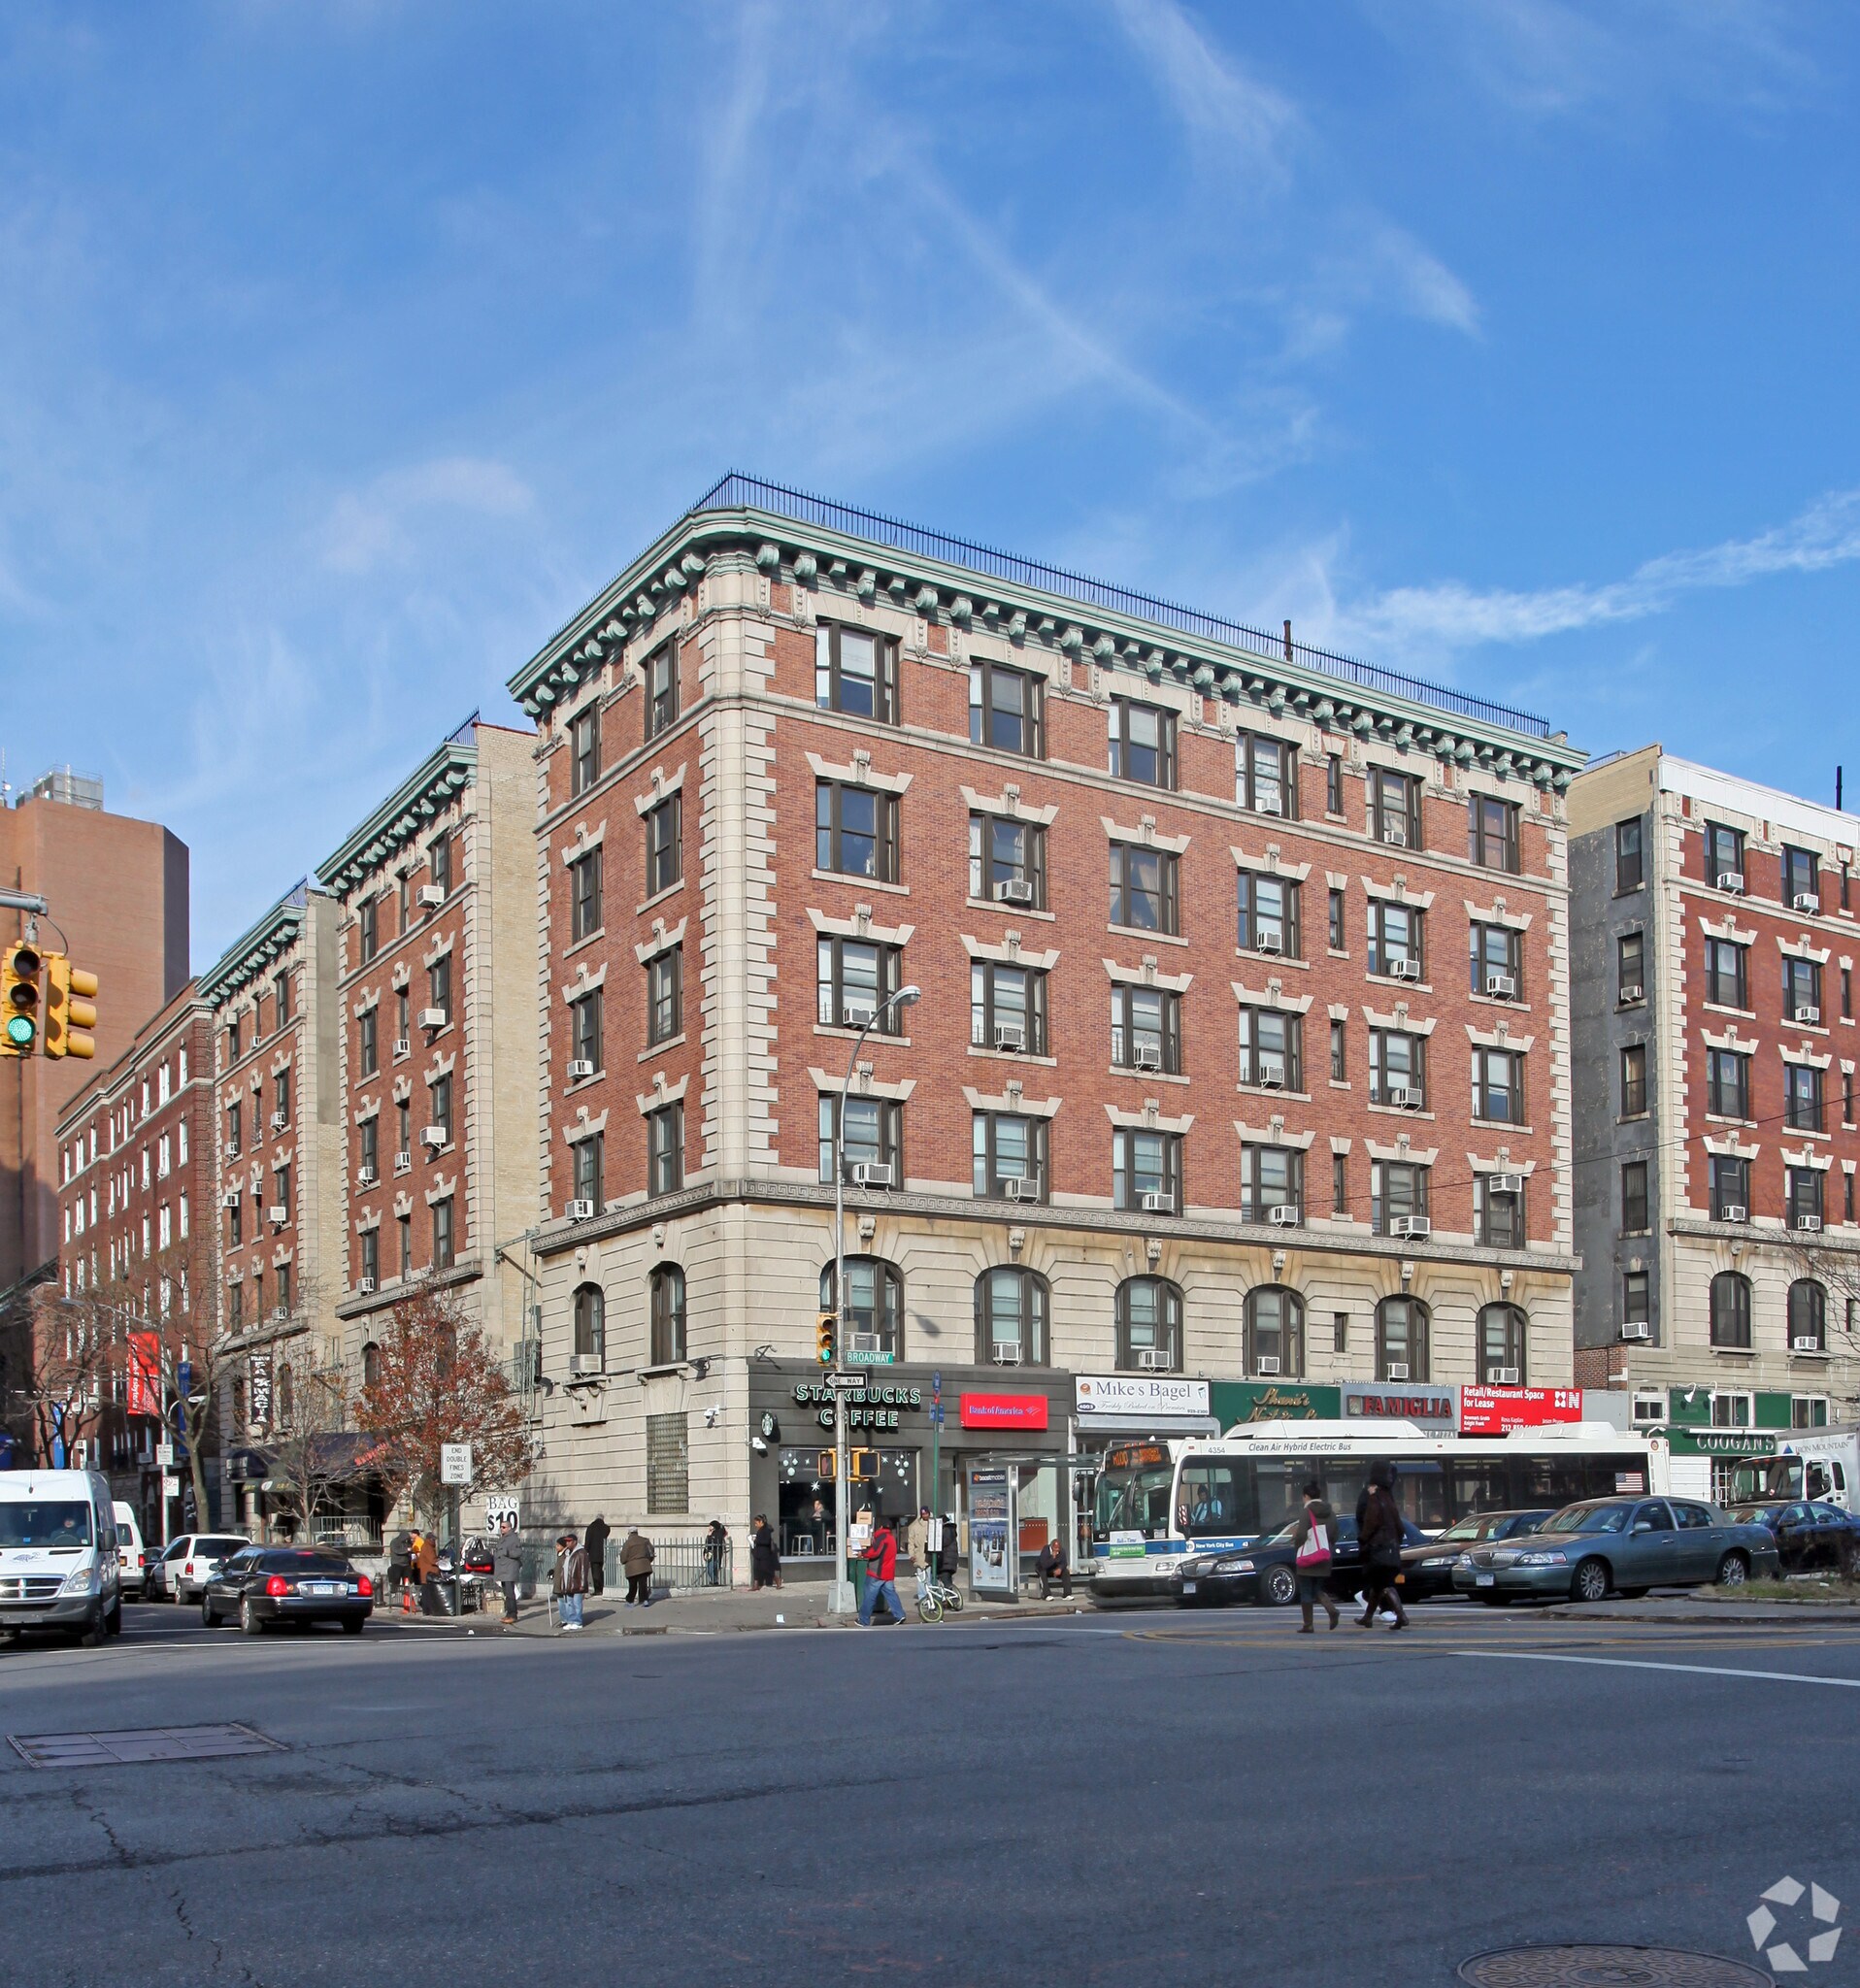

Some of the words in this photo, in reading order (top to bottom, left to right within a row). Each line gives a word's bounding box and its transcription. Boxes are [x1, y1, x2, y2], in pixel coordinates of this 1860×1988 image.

[847, 1351, 890, 1363] BROADWAY
[1096, 1381, 1146, 1396] Mikes
[1149, 1382, 1191, 1401] Bagel
[1463, 1386, 1523, 1399] Retail/Restaurant
[1524, 1389, 1544, 1401] Space
[1362, 1395, 1453, 1418] FAMIGLIA
[1463, 1397, 1474, 1408] for
[1475, 1398, 1495, 1408] Lease
[969, 1406, 987, 1414] Bank
[987, 1406, 995, 1414] of
[995, 1406, 1024, 1415] America
[1248, 1442, 1269, 1451] Clean
[1271, 1442, 1281, 1451] Air
[1283, 1442, 1308, 1454] Hybrid
[1310, 1442, 1336, 1451] Electric
[1338, 1442, 1351, 1451] Bus
[1696, 1434, 1775, 1451] COOGANS
[1795, 1444, 1811, 1453] IRON
[1811, 1441, 1849, 1452] MOUNTAIN
[488, 1495, 518, 1509] BAG
[487, 1510, 517, 1533] $10
